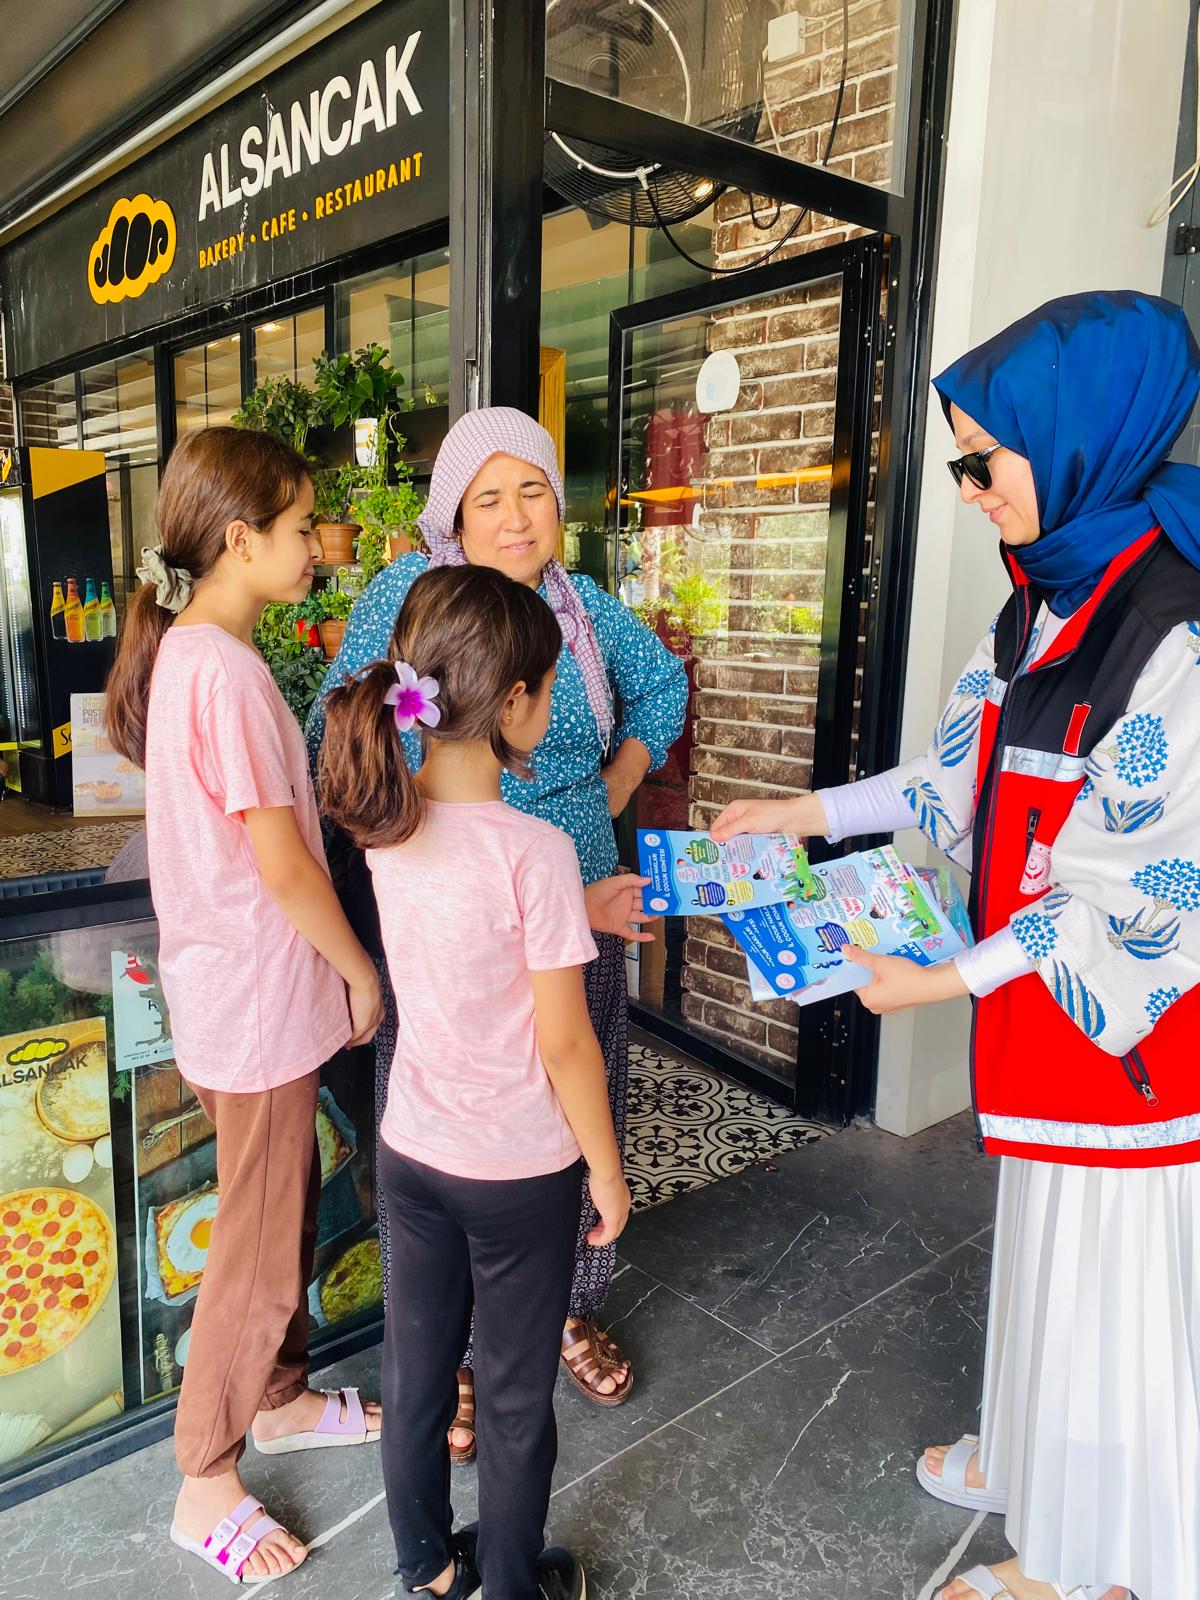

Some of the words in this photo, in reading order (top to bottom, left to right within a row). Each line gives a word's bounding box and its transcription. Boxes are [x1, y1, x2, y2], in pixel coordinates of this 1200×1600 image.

[199, 31, 423, 222] ALSANCAK
[199, 232, 245, 269] BAKERY
[262, 209, 296, 241] CAFE
[315, 152, 423, 219] RESTAURANT
[762, 906, 774, 925] HAKLA
[0, 1054, 88, 1088] LSANCAK
